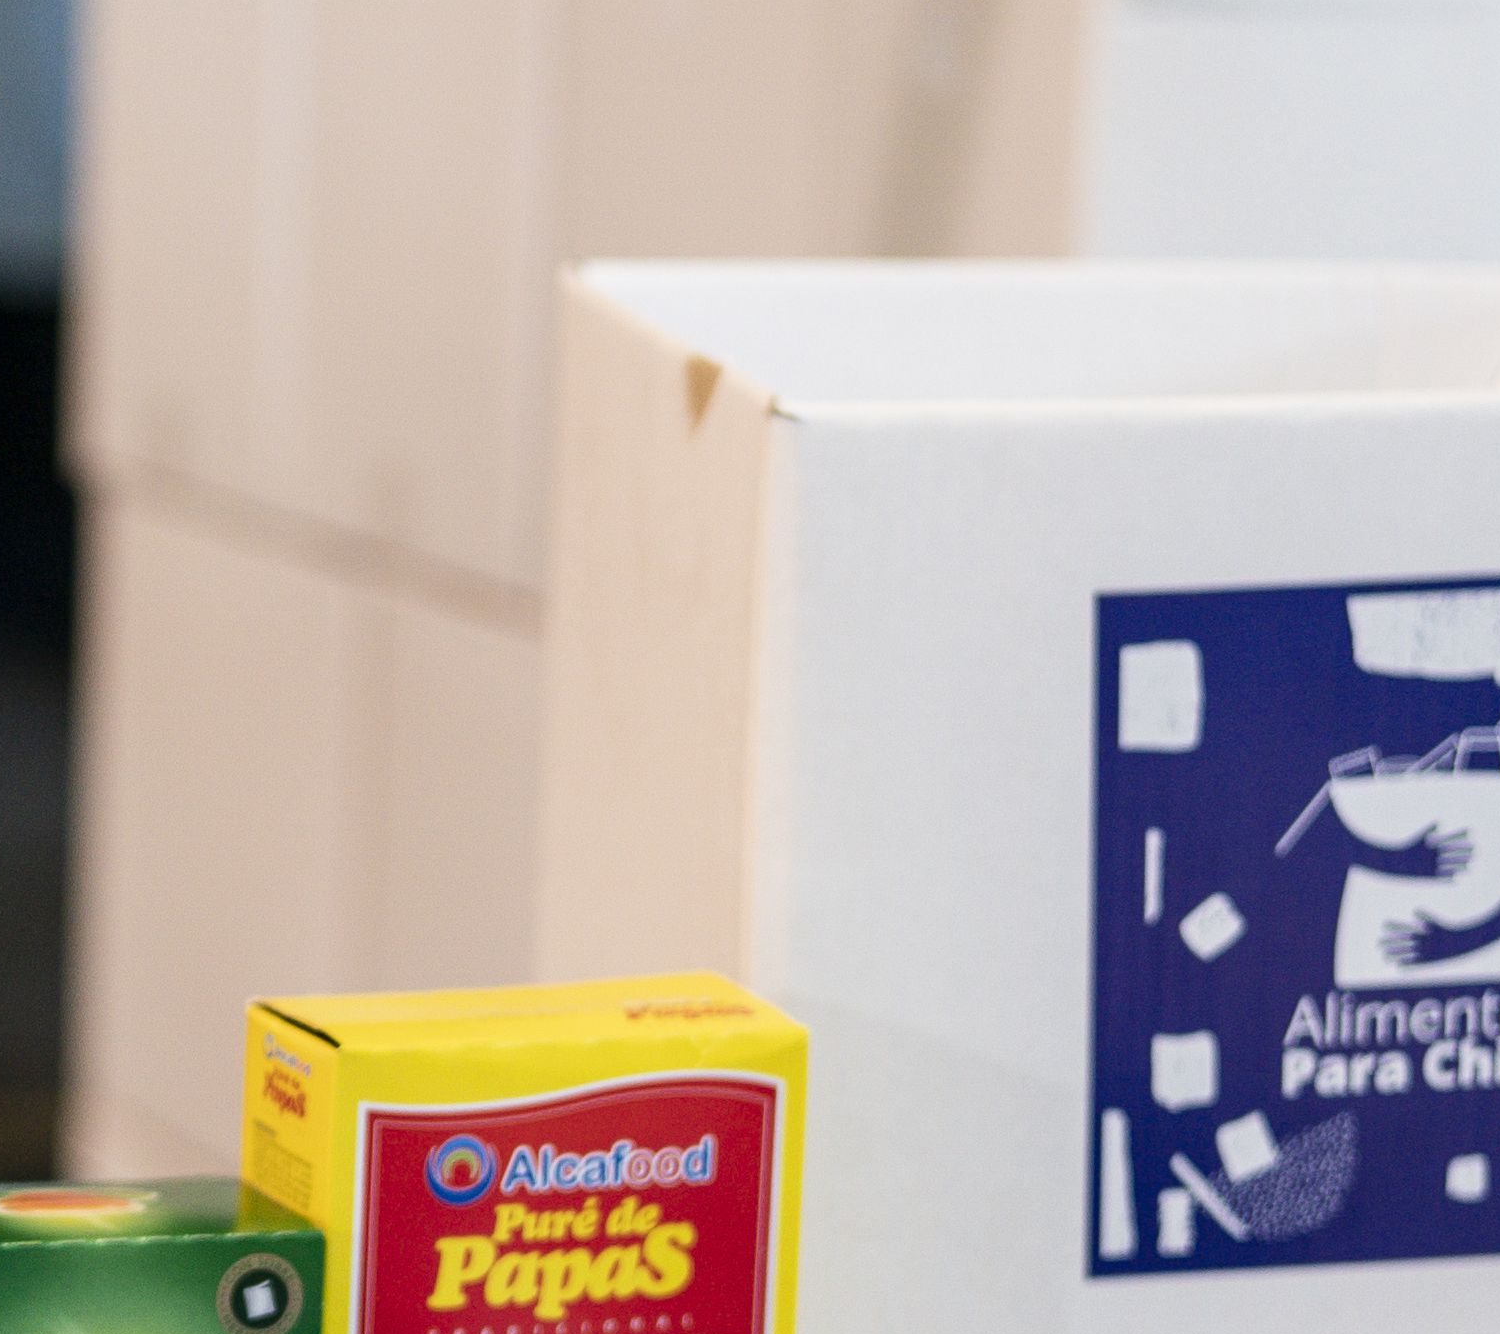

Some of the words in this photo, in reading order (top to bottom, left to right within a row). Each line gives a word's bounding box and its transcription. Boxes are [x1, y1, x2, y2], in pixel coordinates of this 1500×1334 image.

[1281, 1047, 1412, 1100] Para
[501, 1134, 717, 1194] Alcafood
[494, 1196, 598, 1242] Puré
[607, 1196, 661, 1239] de
